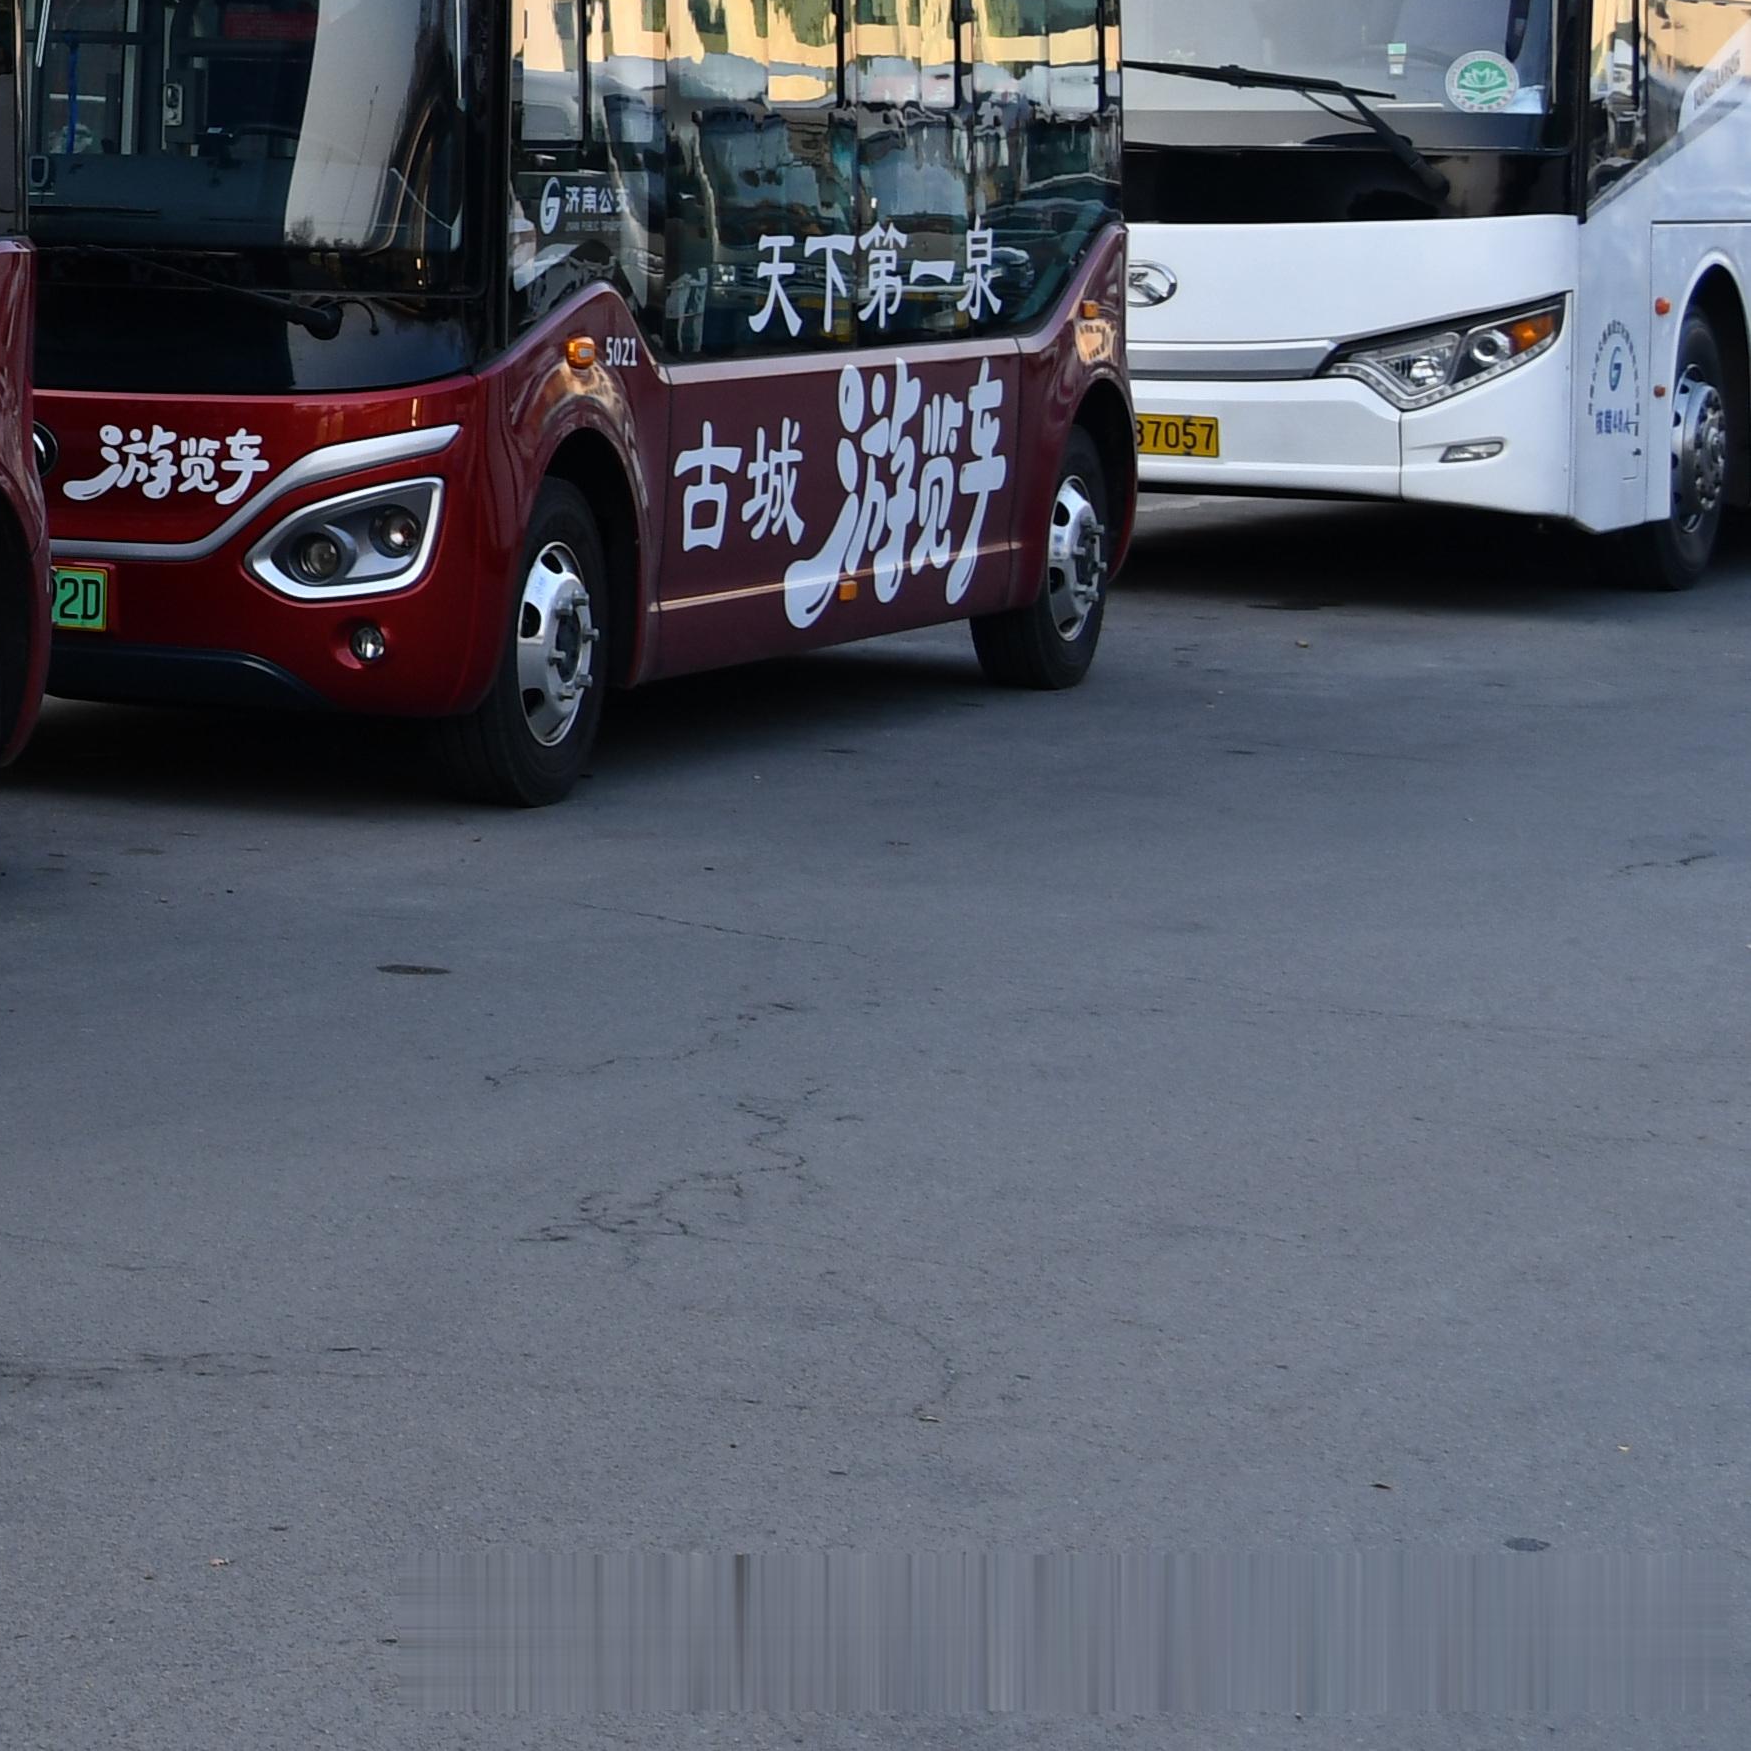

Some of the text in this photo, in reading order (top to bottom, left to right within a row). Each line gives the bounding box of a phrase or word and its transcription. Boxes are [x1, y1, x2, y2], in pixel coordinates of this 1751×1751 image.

[564, 186, 630, 214] 济南公交
[748, 215, 1001, 336] 天下第一泉
[605, 337, 638, 367] 5021
[63, 424, 269, 505] 游览车
[674, 356, 1007, 628] 古城 游览车
